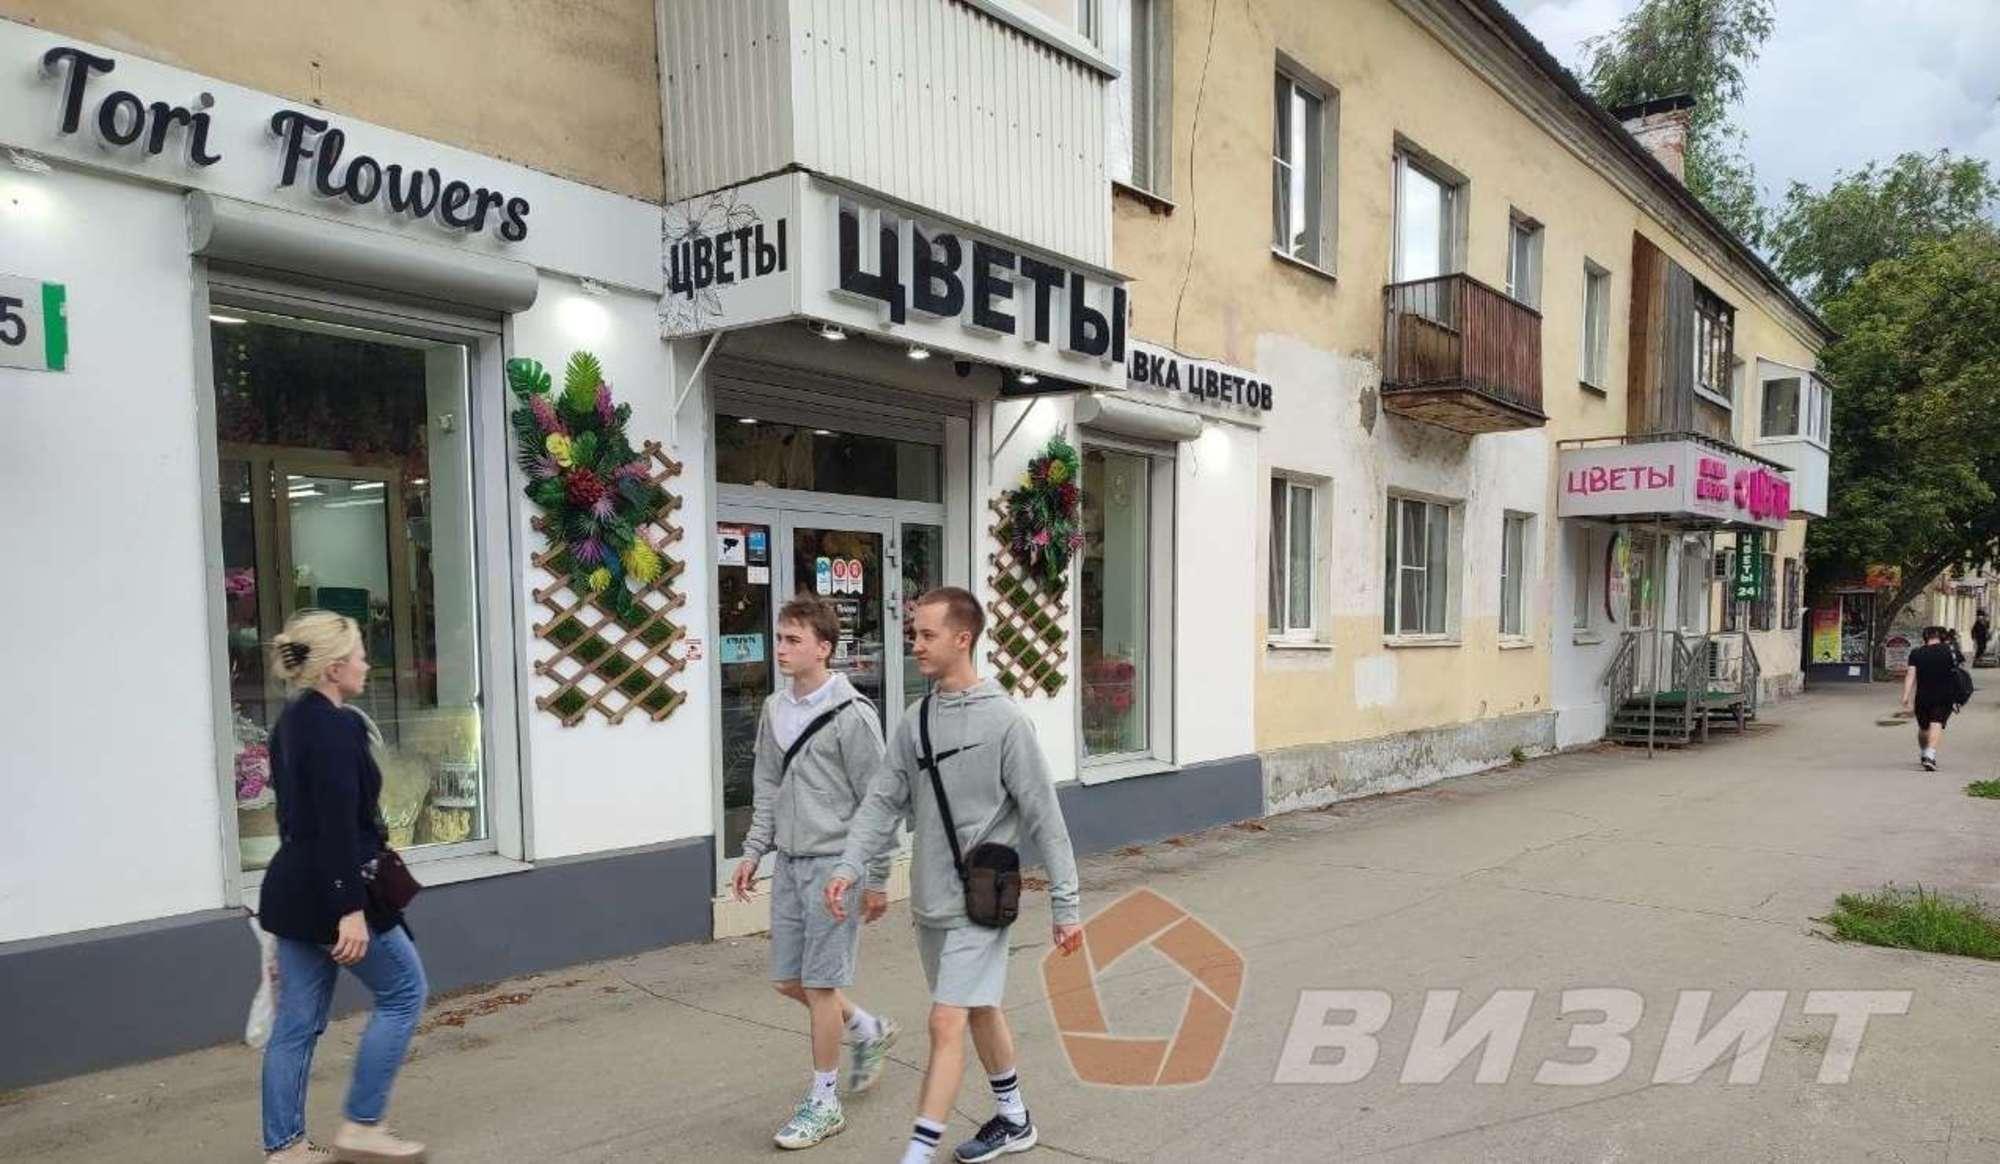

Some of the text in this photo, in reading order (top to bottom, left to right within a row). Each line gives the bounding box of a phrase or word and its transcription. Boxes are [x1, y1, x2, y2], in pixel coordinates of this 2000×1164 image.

[42, 46, 530, 242] Tori Flowers
[670, 218, 787, 300] ЦВЕТЫ
[838, 208, 1126, 363] ЦВЕТЫ
[1127, 349, 1273, 411] ВКА ЦВЕТОВ
[1567, 465, 1675, 495] ЦВЕТЫ
